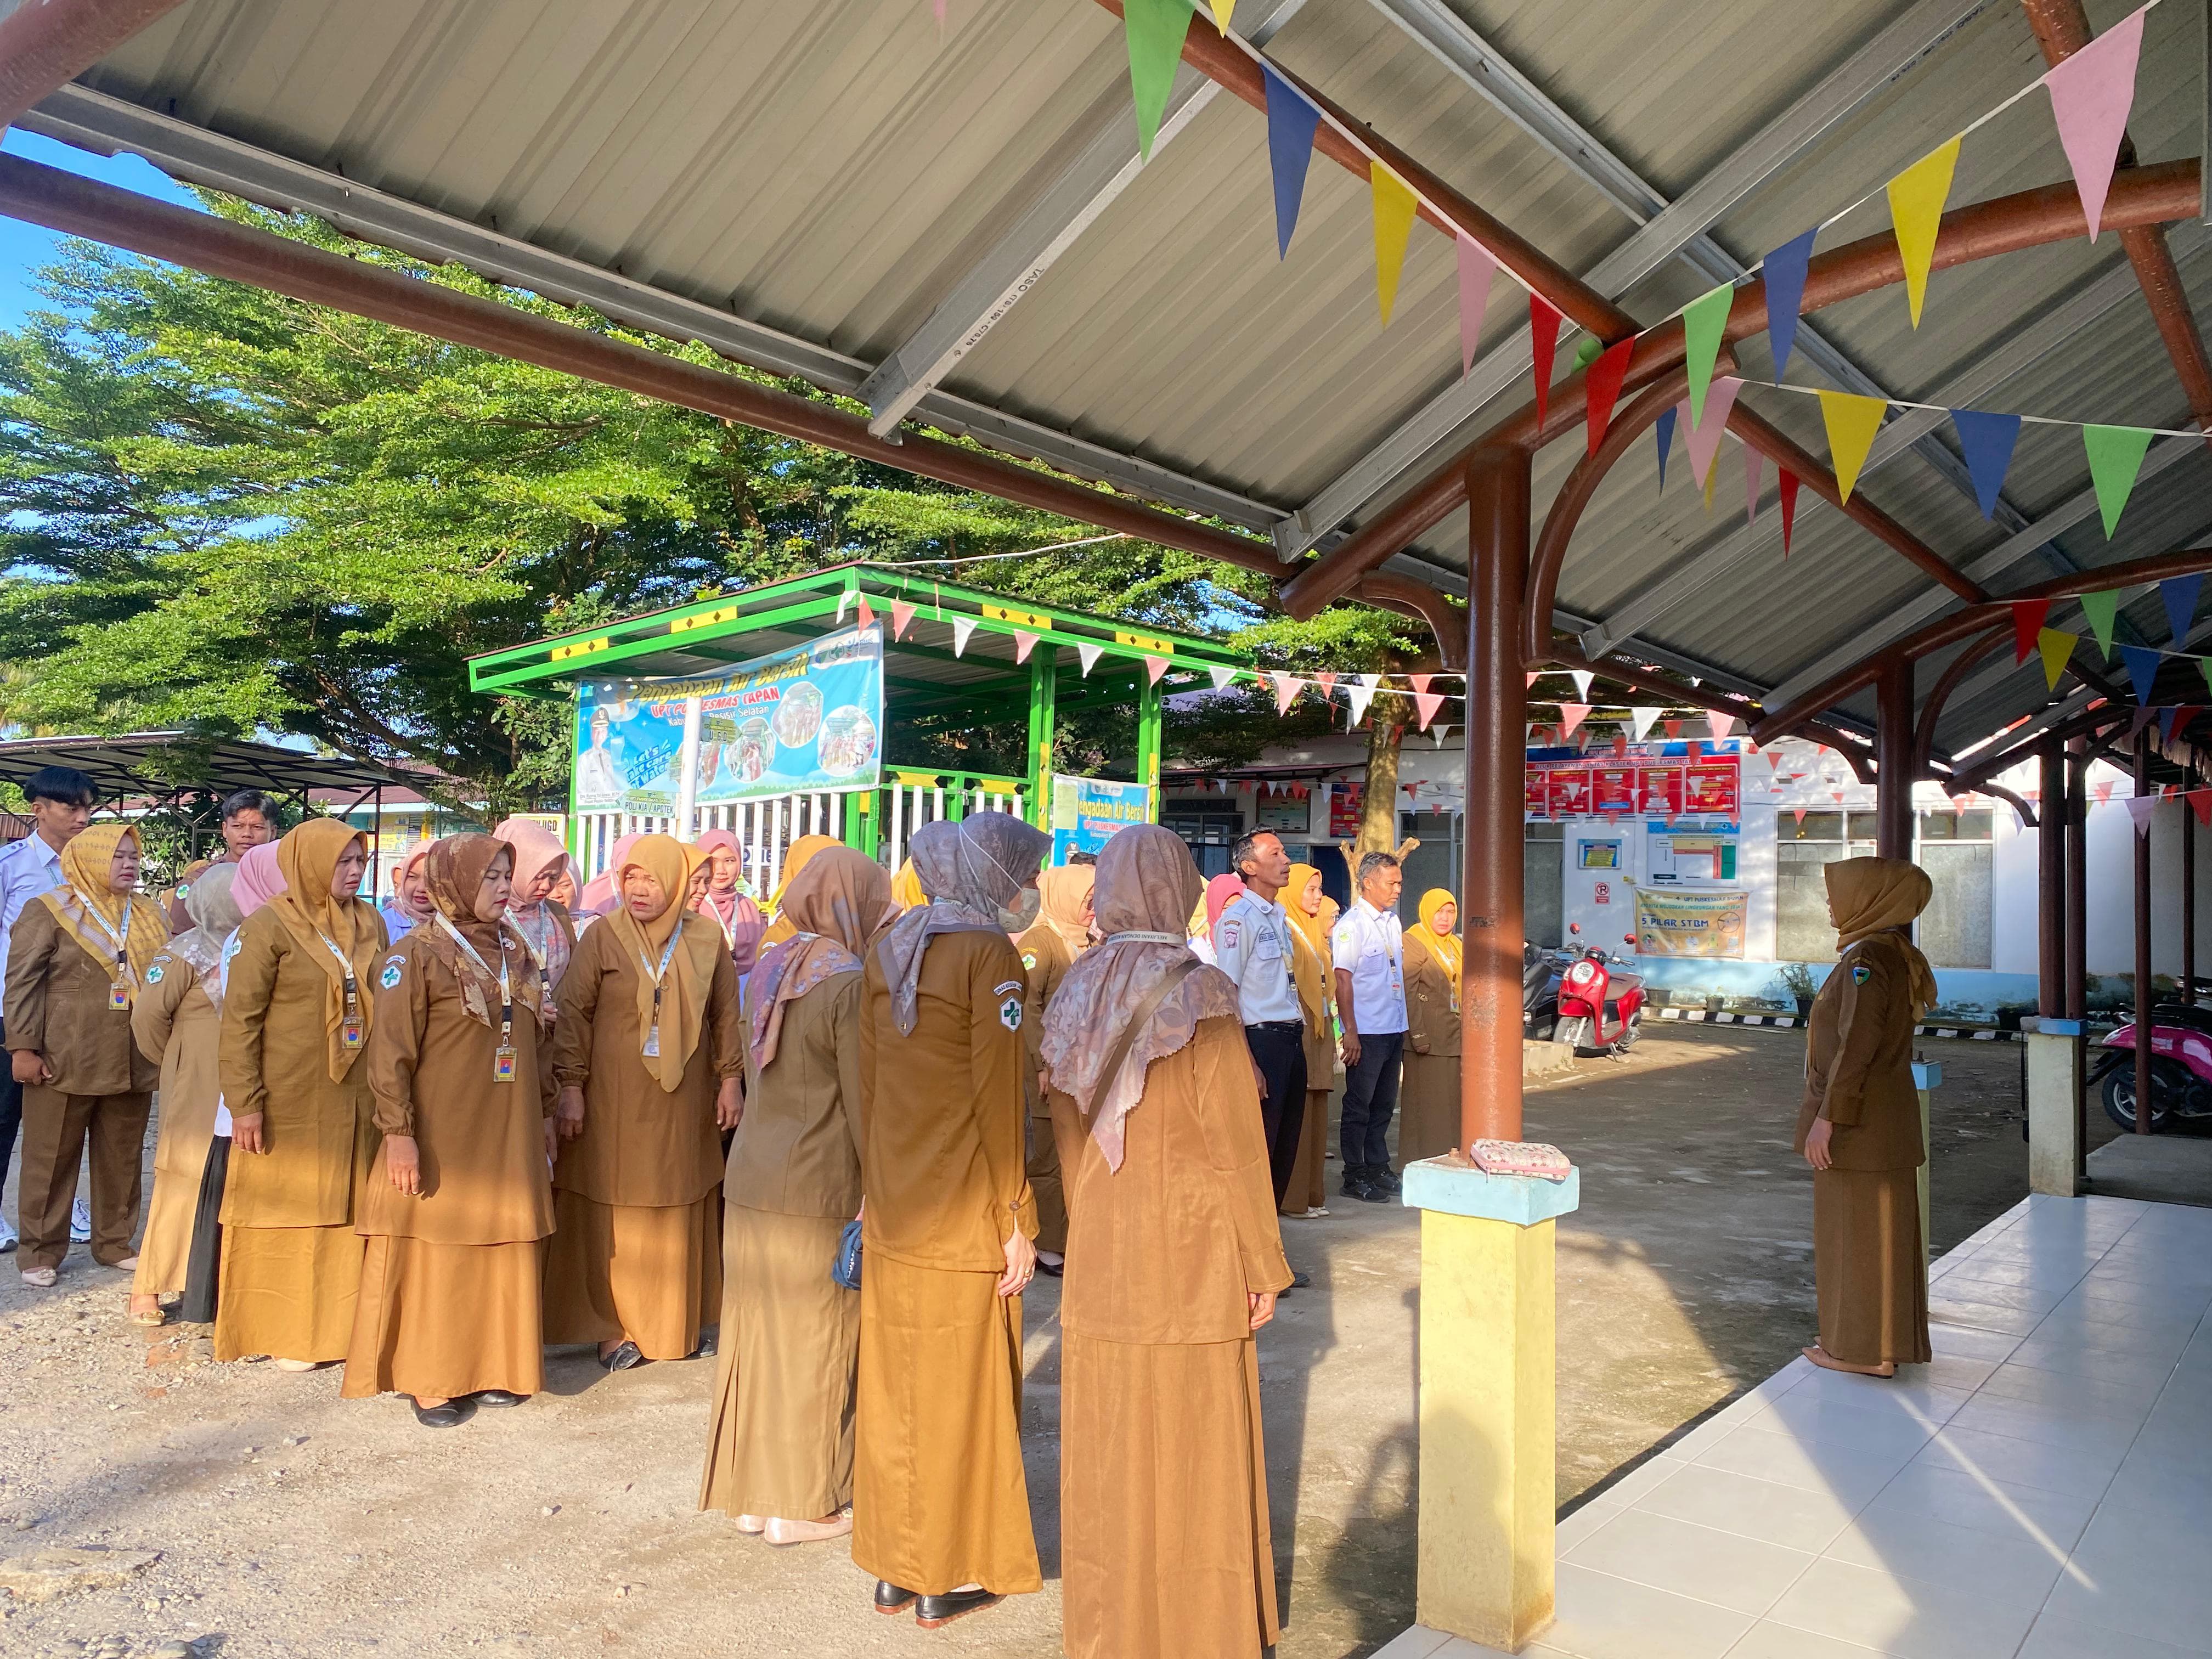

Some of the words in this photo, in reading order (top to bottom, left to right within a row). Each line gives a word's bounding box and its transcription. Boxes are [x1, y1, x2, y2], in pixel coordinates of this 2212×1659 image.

[1018, 268, 1045, 292] TASO
[652, 704, 671, 716] UPT
[674, 696, 739, 714] PUESMAS
[743, 687, 780, 704] TAPAN
[739, 706, 769, 716] Selatan
[646, 751, 672, 769] care
[625, 802, 636, 810] POLI
[653, 804, 674, 814] APOTEK
[1078, 798, 1113, 820] engadaan
[1651, 918, 1677, 927] PILAR
